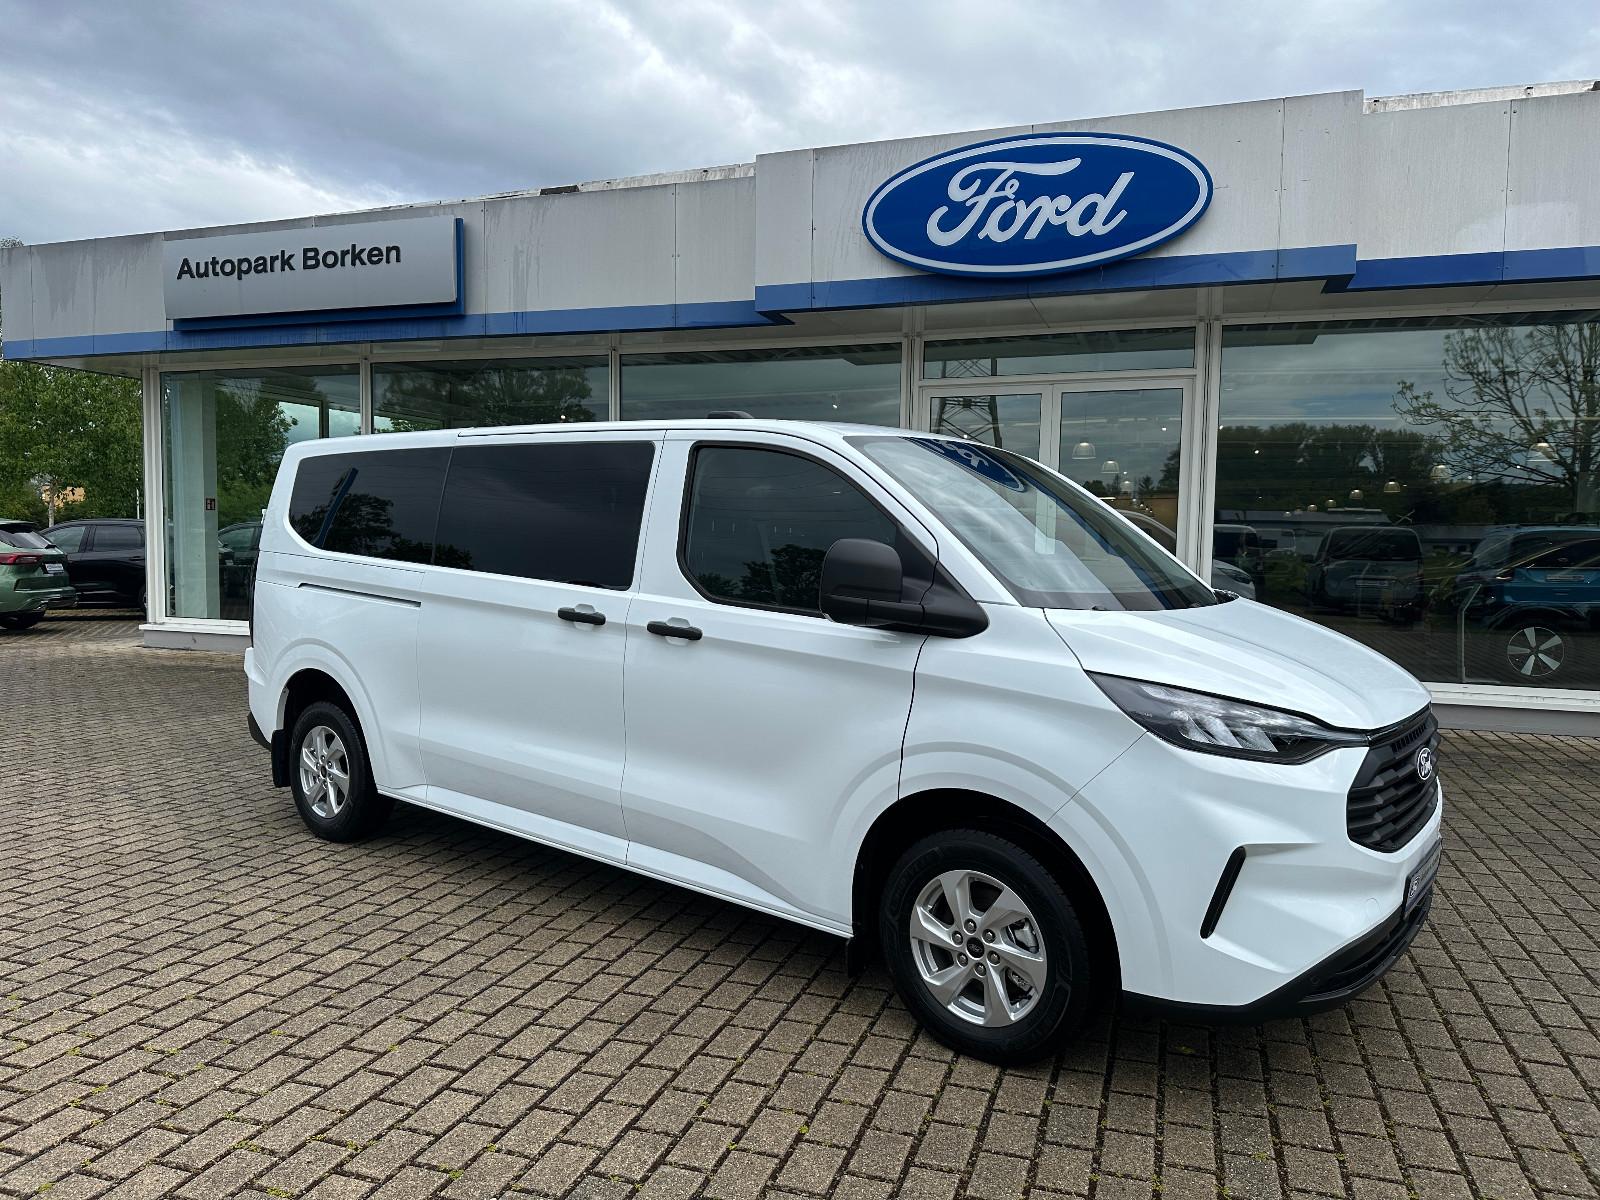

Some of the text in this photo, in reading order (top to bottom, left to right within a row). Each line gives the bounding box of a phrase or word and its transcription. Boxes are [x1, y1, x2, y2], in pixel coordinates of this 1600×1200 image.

[927, 157, 1135, 247] Ford
[176, 243, 401, 281] Autopark Borken
